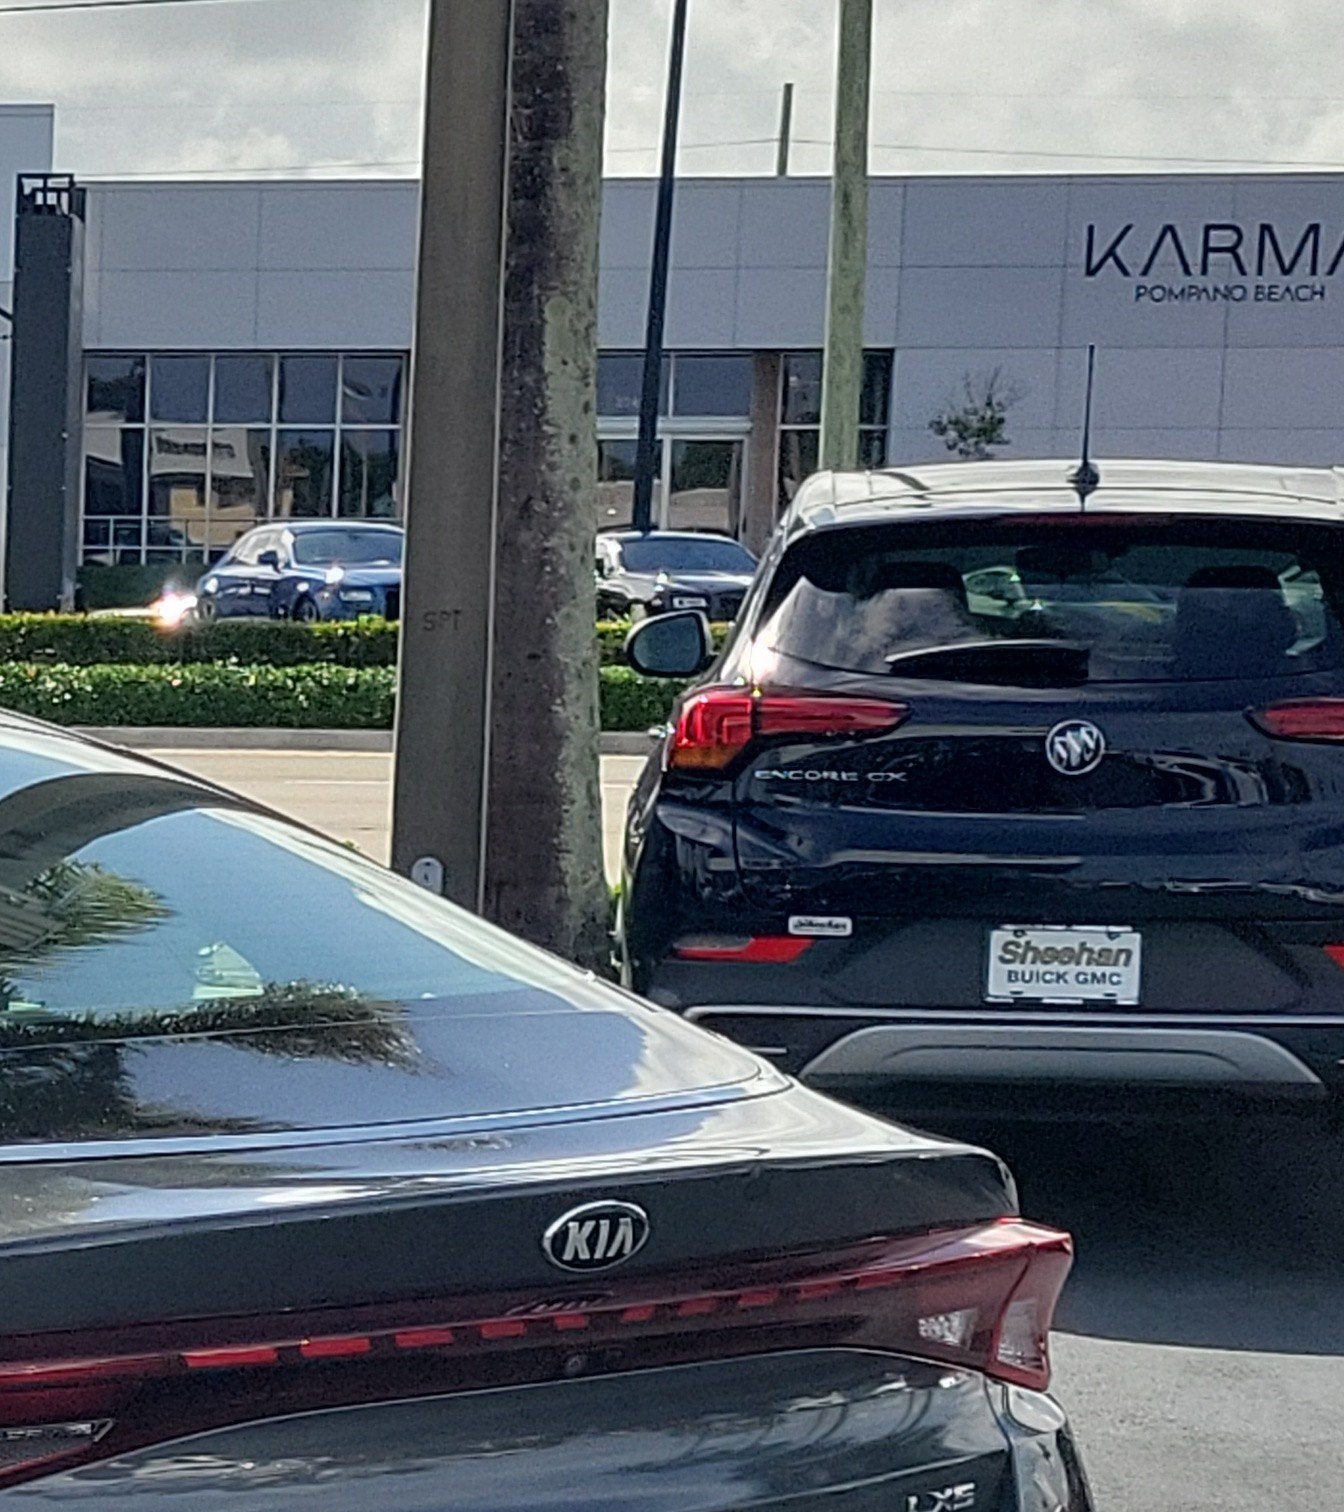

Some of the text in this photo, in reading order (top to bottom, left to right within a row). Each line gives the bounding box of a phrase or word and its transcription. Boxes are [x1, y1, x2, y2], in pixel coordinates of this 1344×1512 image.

[1135, 284, 1326, 302] POMPANO BEACH
[754, 770, 859, 782] ENCORE
[998, 940, 1133, 967] Sheehan
[1007, 970, 1123, 986] BUICK GMC
[560, 1215, 635, 1263] KIA
